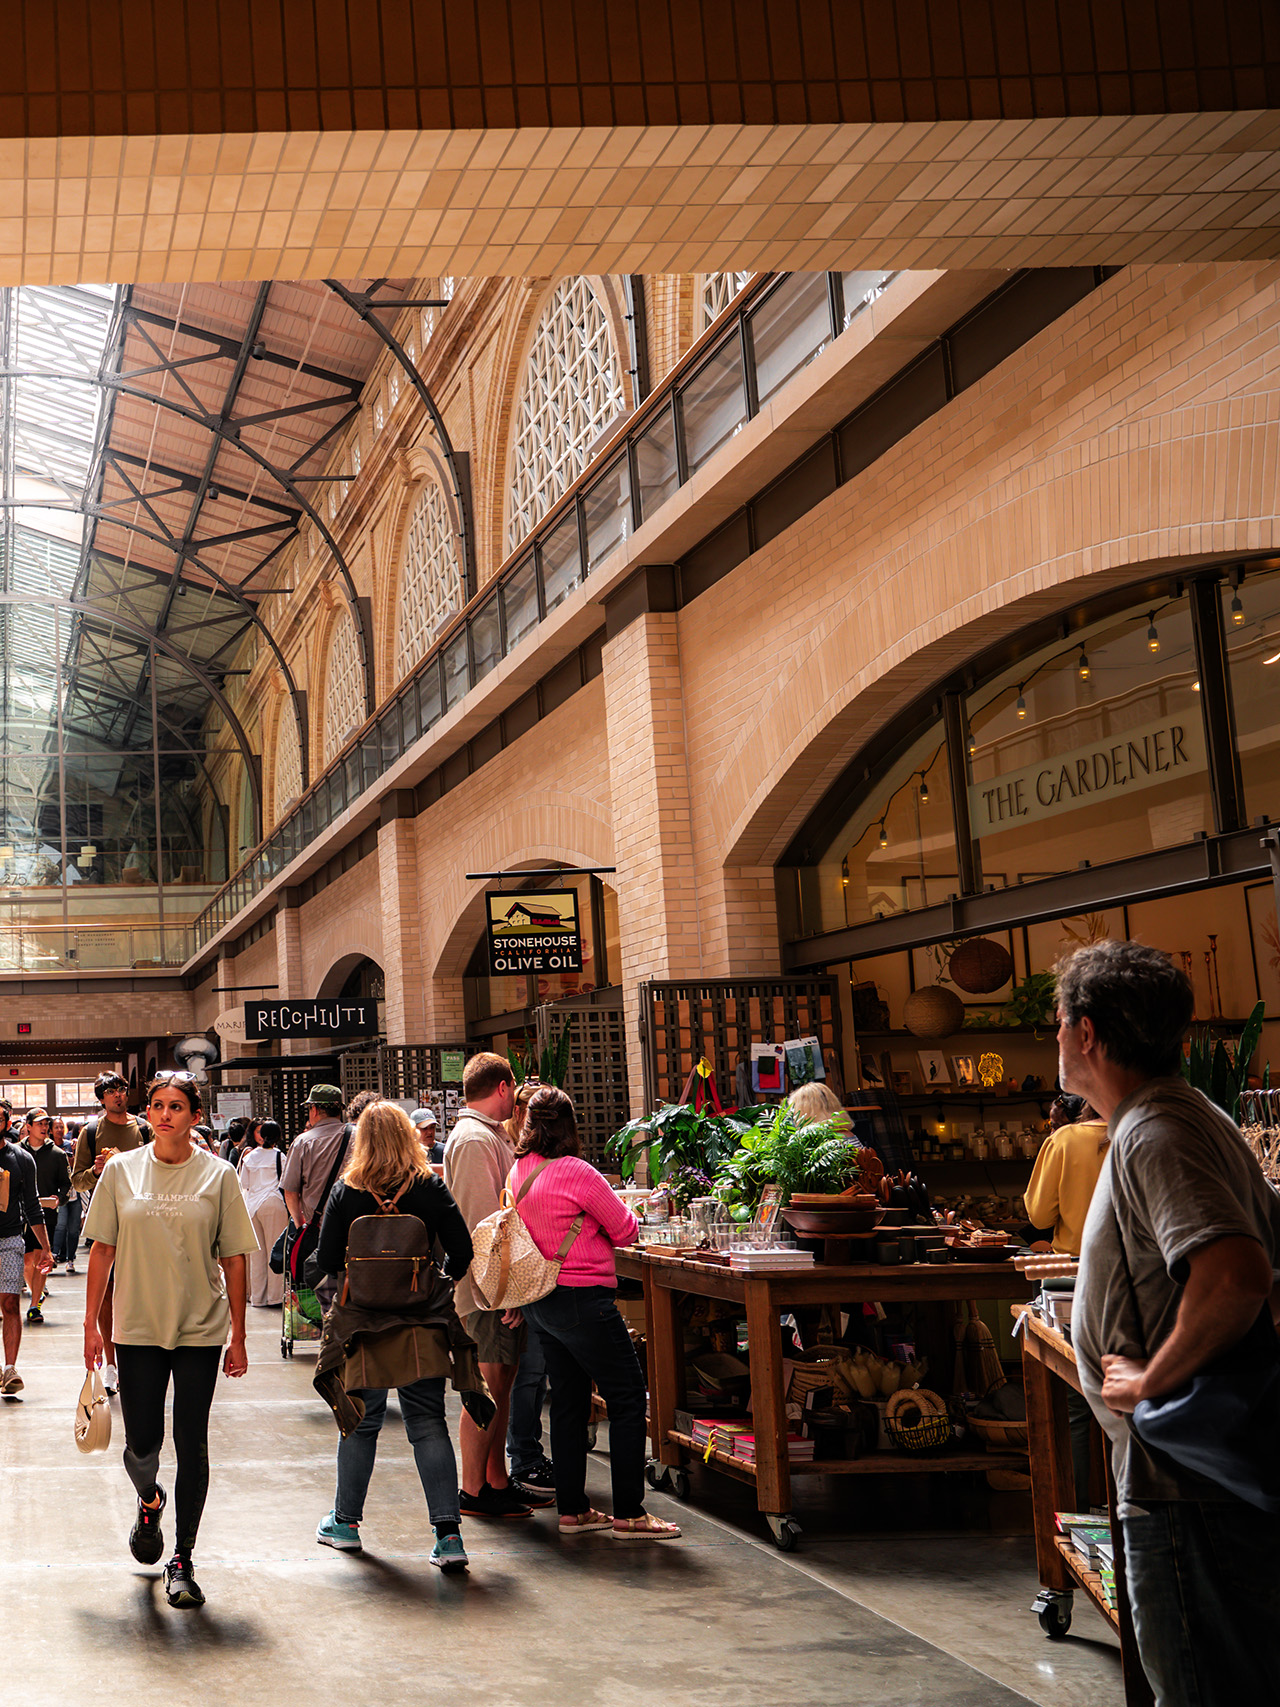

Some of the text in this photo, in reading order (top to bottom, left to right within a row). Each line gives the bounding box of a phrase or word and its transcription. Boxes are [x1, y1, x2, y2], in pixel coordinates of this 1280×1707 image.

[982, 724, 1190, 825] THE GARDENER
[3, 872, 28, 886] 275
[493, 935, 577, 949] STONEHOUSE
[499, 948, 571, 956] CALIFORNIA
[494, 955, 578, 971] OLIVE OIL
[257, 1004, 366, 1032] RECCHIUTI
[157, 1193, 200, 1202] HAMPTON
